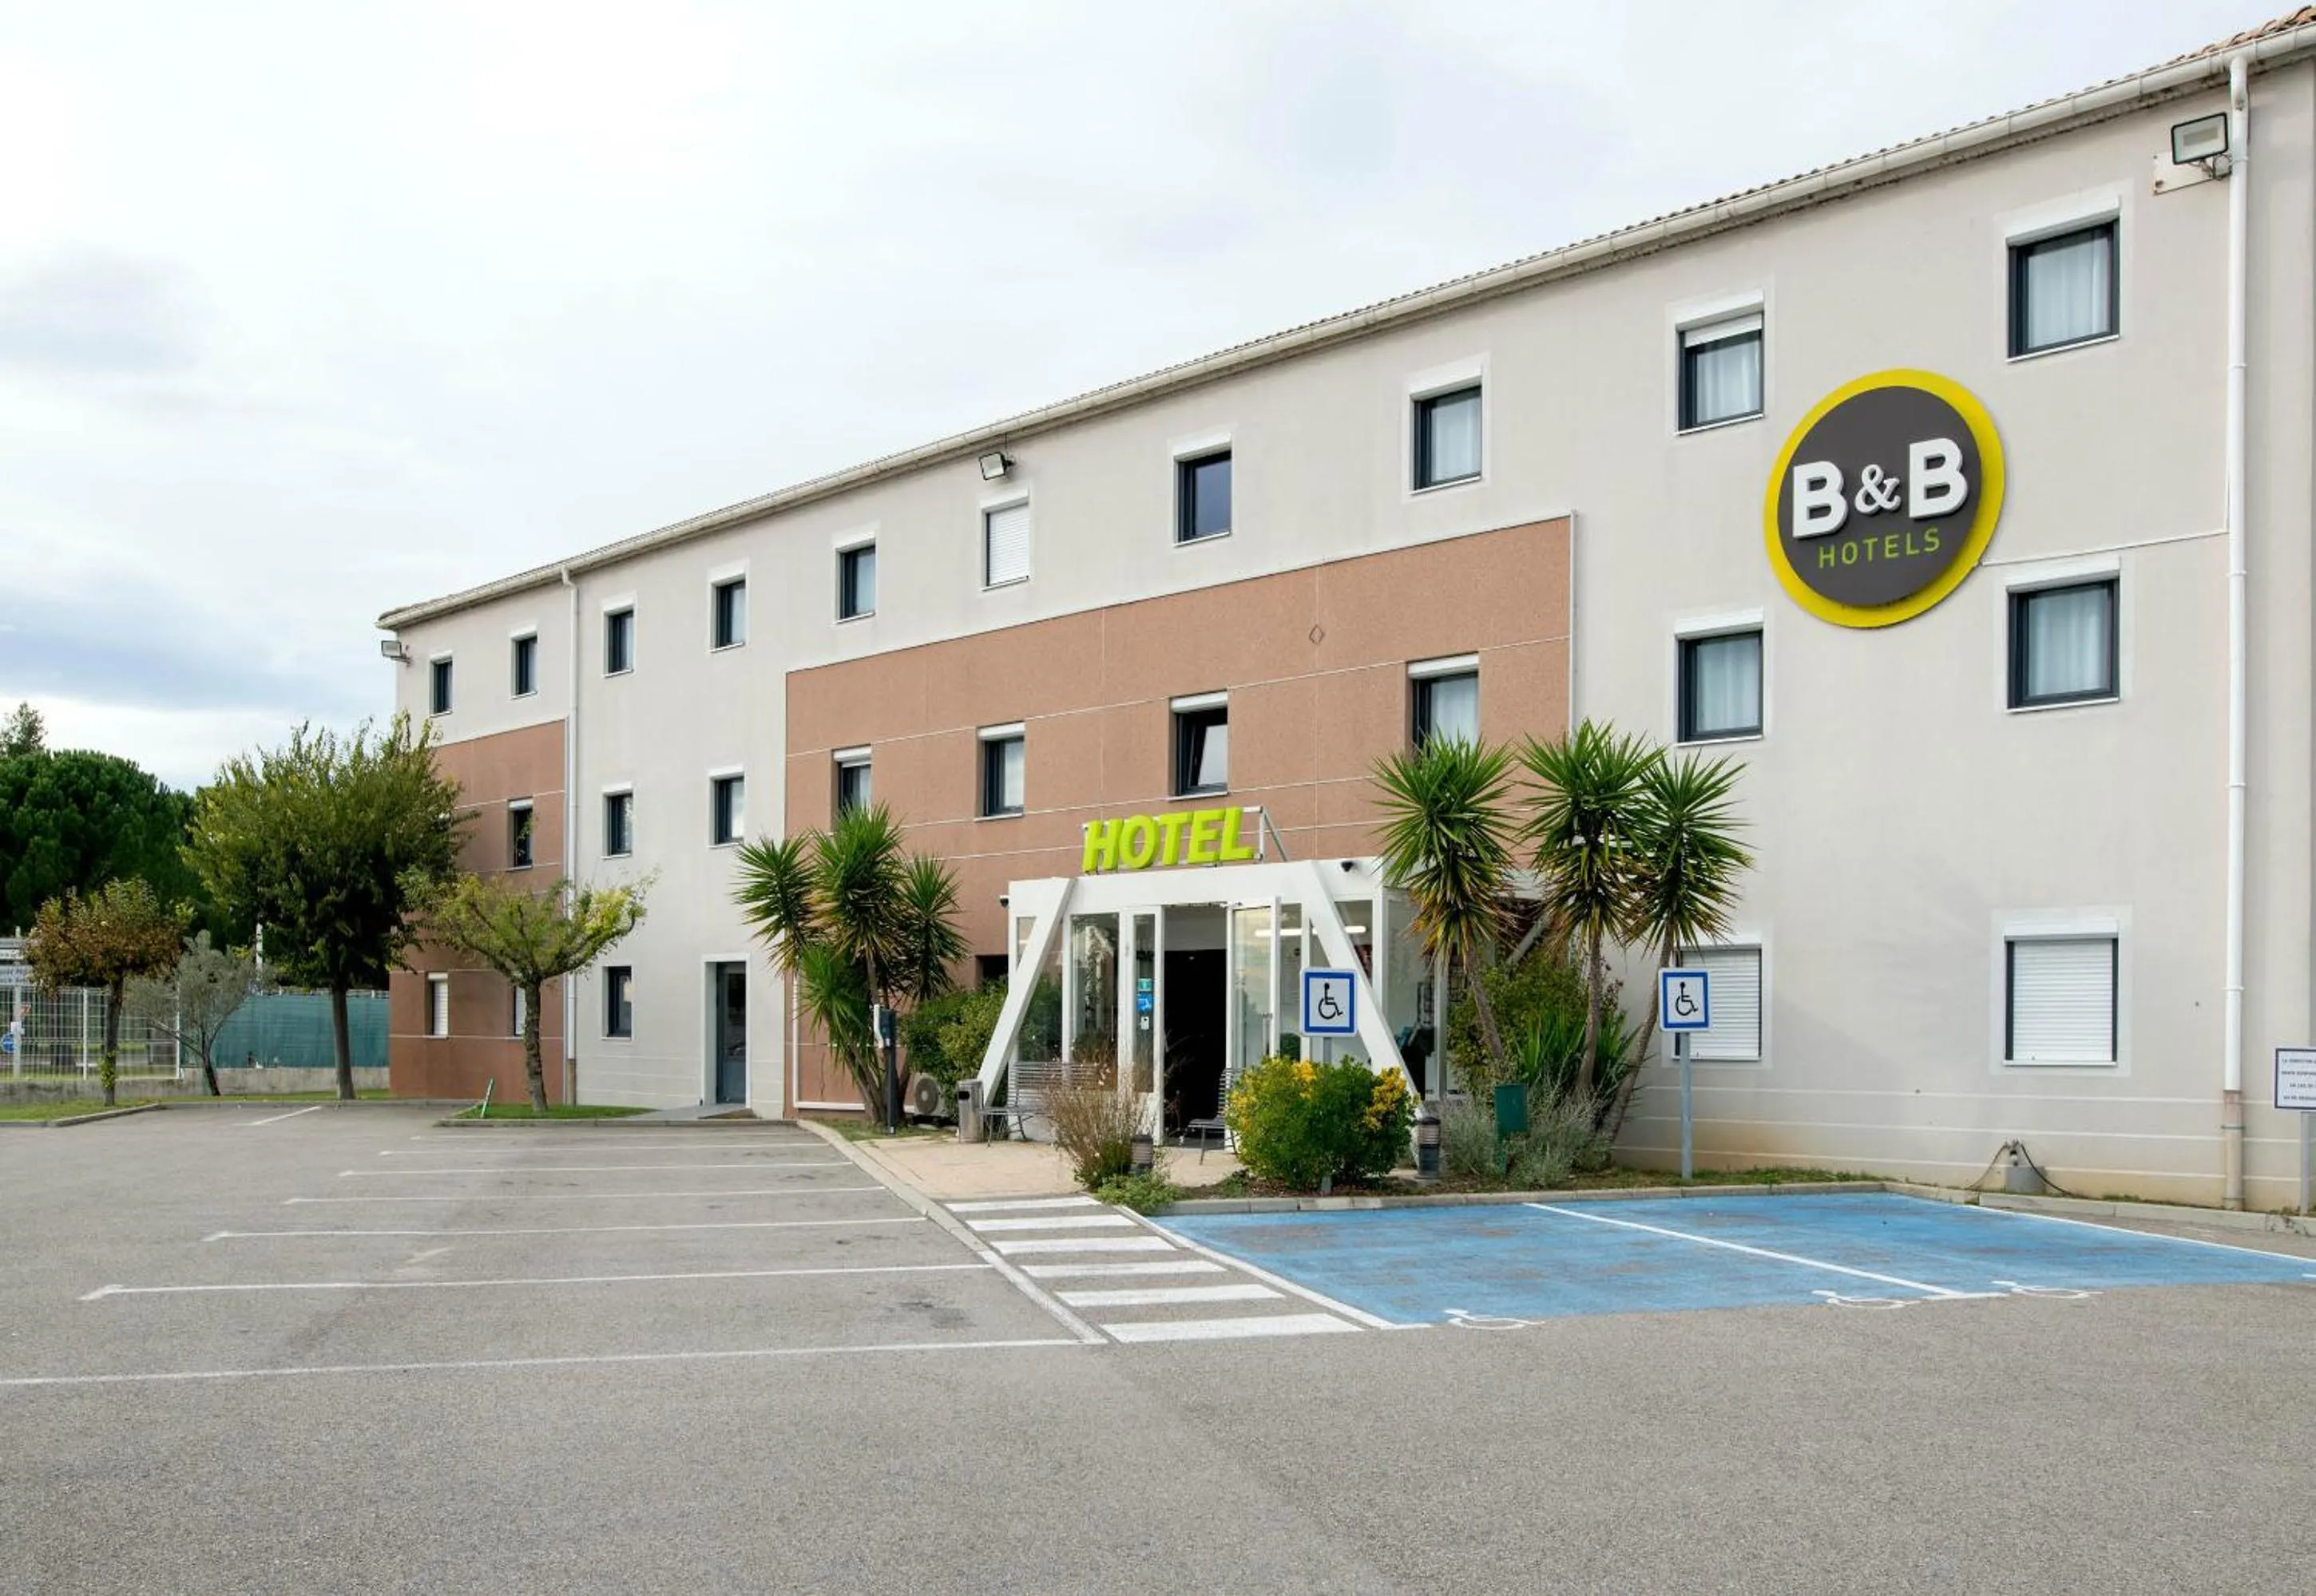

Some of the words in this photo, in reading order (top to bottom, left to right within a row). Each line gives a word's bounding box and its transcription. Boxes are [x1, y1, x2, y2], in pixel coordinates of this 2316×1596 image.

[1792, 438, 1969, 539] B&B
[1818, 527, 1941, 569] HOTELS
[1082, 806, 1255, 873] HOTEL
